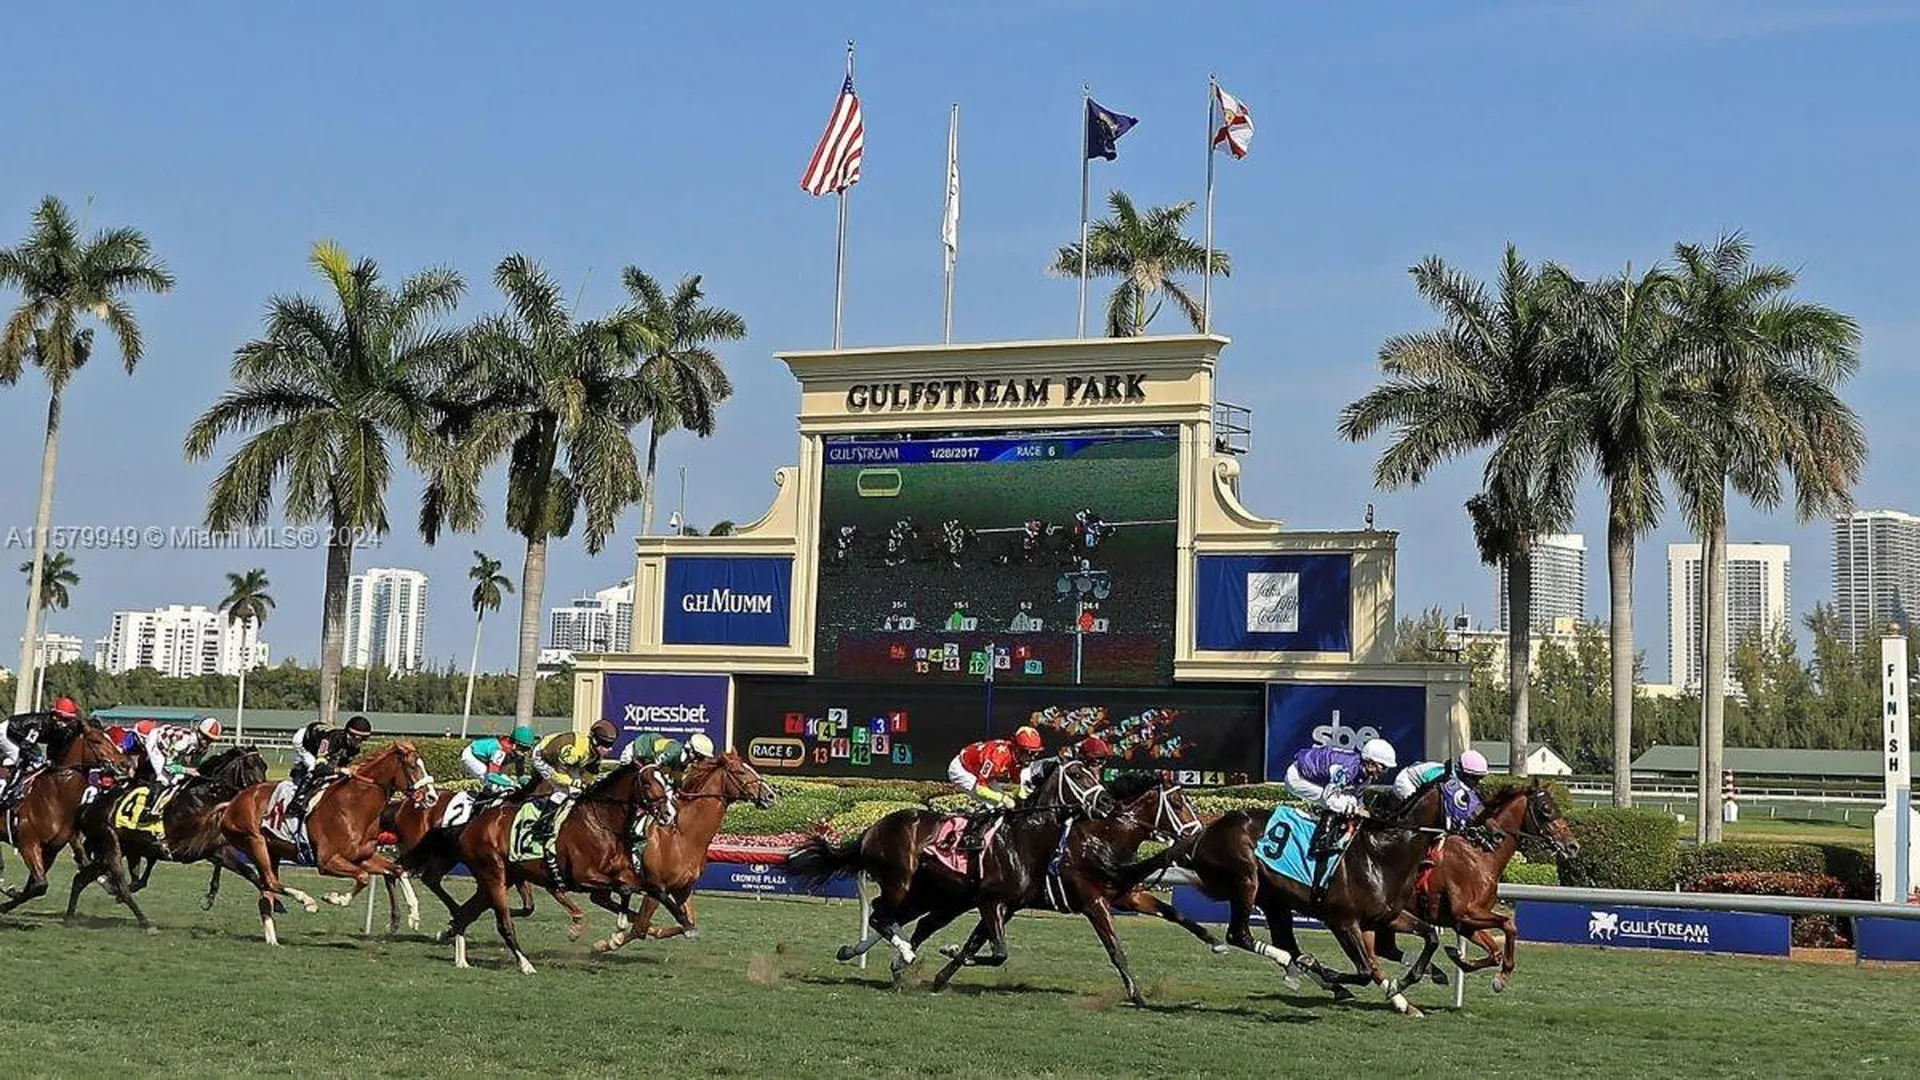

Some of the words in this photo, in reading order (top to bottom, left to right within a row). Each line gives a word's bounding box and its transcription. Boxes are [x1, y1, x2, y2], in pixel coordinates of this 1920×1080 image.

[847, 376, 1050, 409] GULFSTREAM
[1065, 374, 1147, 403] PARK
[829, 447, 899, 461] GULFSTREAM
[1016, 446, 1042, 457] RACE
[1886, 663, 1899, 773] FINISH
[752, 744, 783, 758] RACE
[786, 745, 793, 758] 6
[812, 747, 829, 764] 13
[1262, 821, 1292, 861] 9
[1619, 919, 1709, 938] GULFSTREAM
